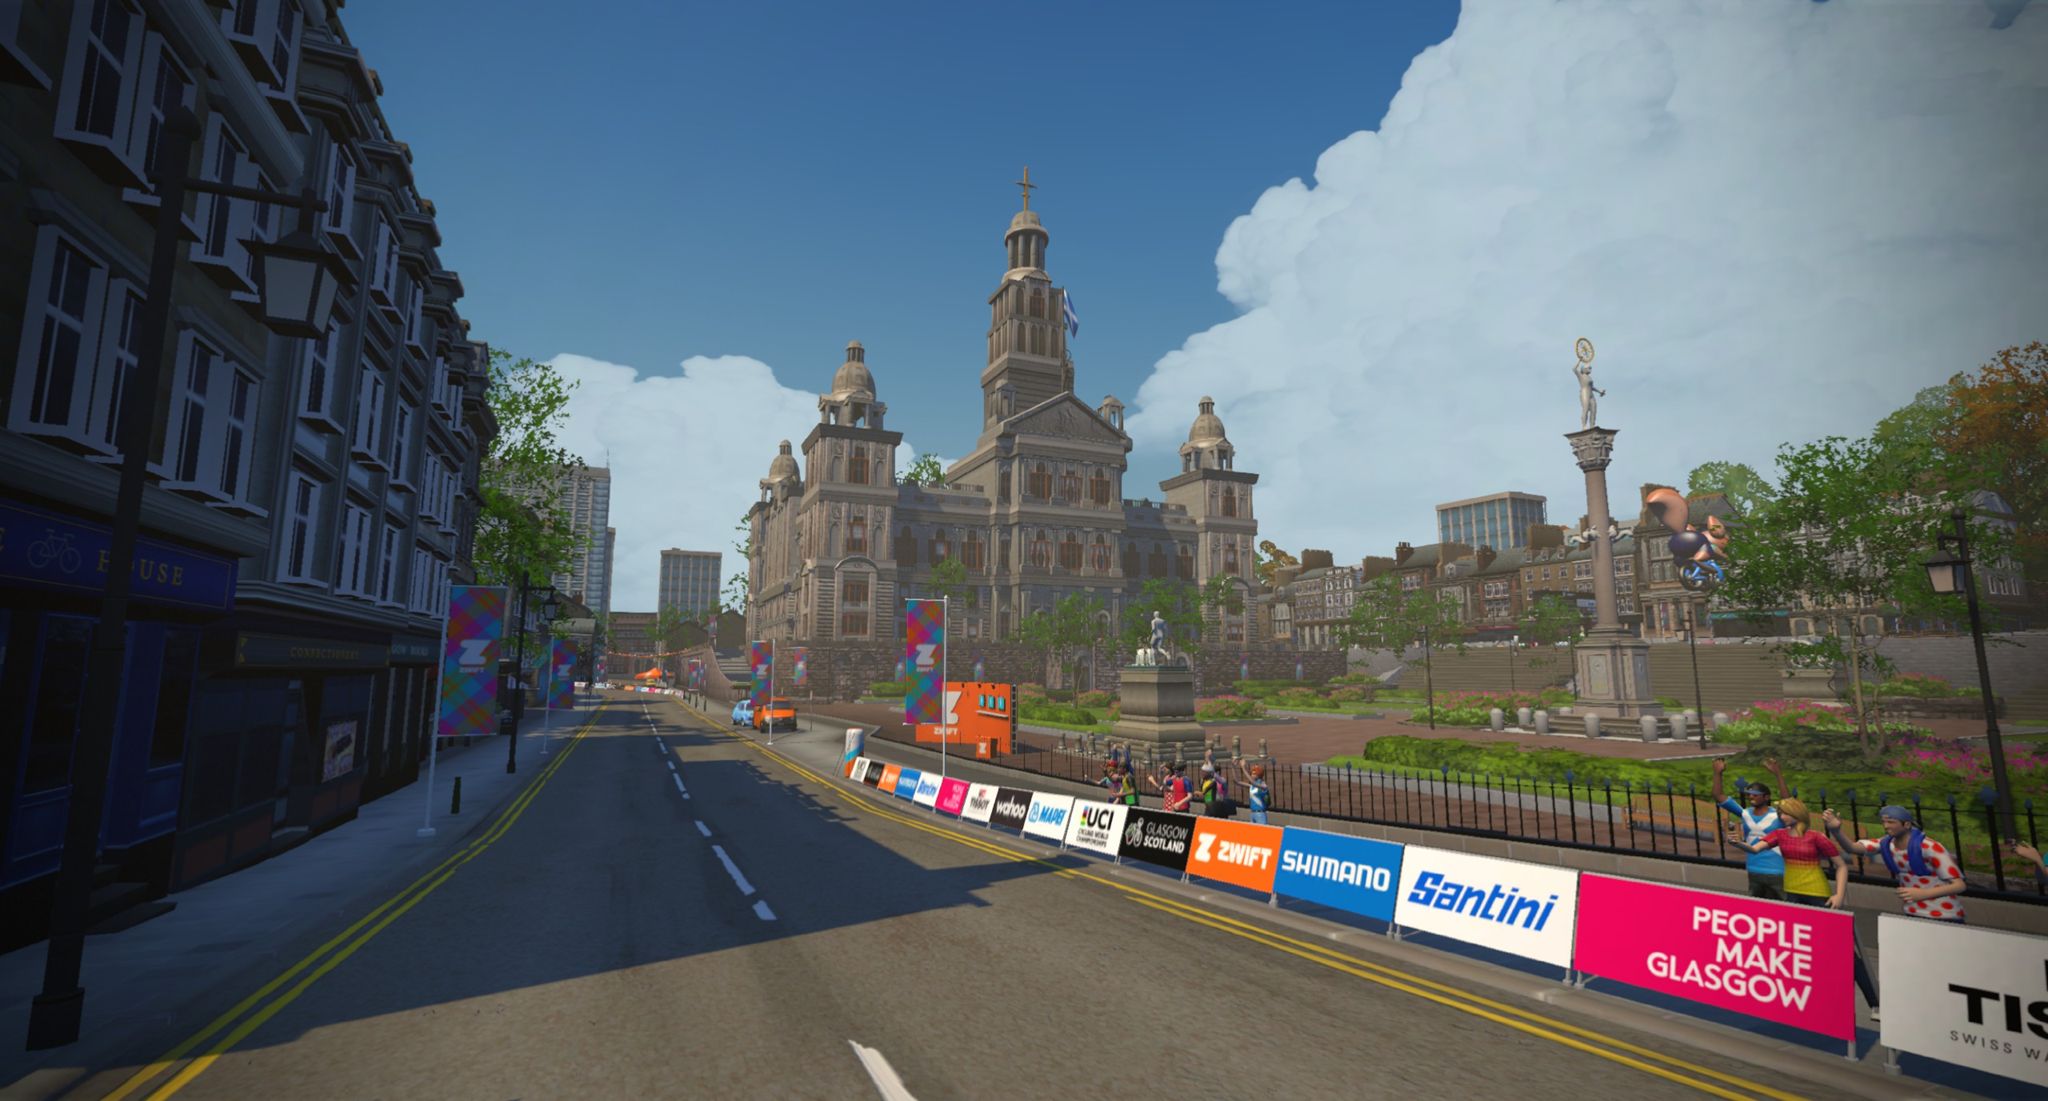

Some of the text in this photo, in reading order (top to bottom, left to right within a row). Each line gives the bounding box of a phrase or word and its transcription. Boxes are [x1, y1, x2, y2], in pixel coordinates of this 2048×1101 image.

[96, 549, 184, 587] HUSE
[970, 797, 990, 810] TISSOT
[996, 795, 1026, 819] wahoo
[1039, 805, 1067, 826] MAPEI
[1087, 806, 1115, 831] UCI
[1143, 836, 1185, 854] SCOTLAND
[1146, 822, 1188, 841] GLASGOW
[1217, 840, 1272, 870] ZWIFT
[1281, 850, 1391, 892] SHIMANO
[1407, 870, 1559, 932] Santini
[1692, 906, 1812, 953] PEOPLE
[1716, 937, 1812, 983] MAKE
[1646, 951, 1812, 1012] GLASGOW
[1950, 1030, 2048, 1063] SWISS W
